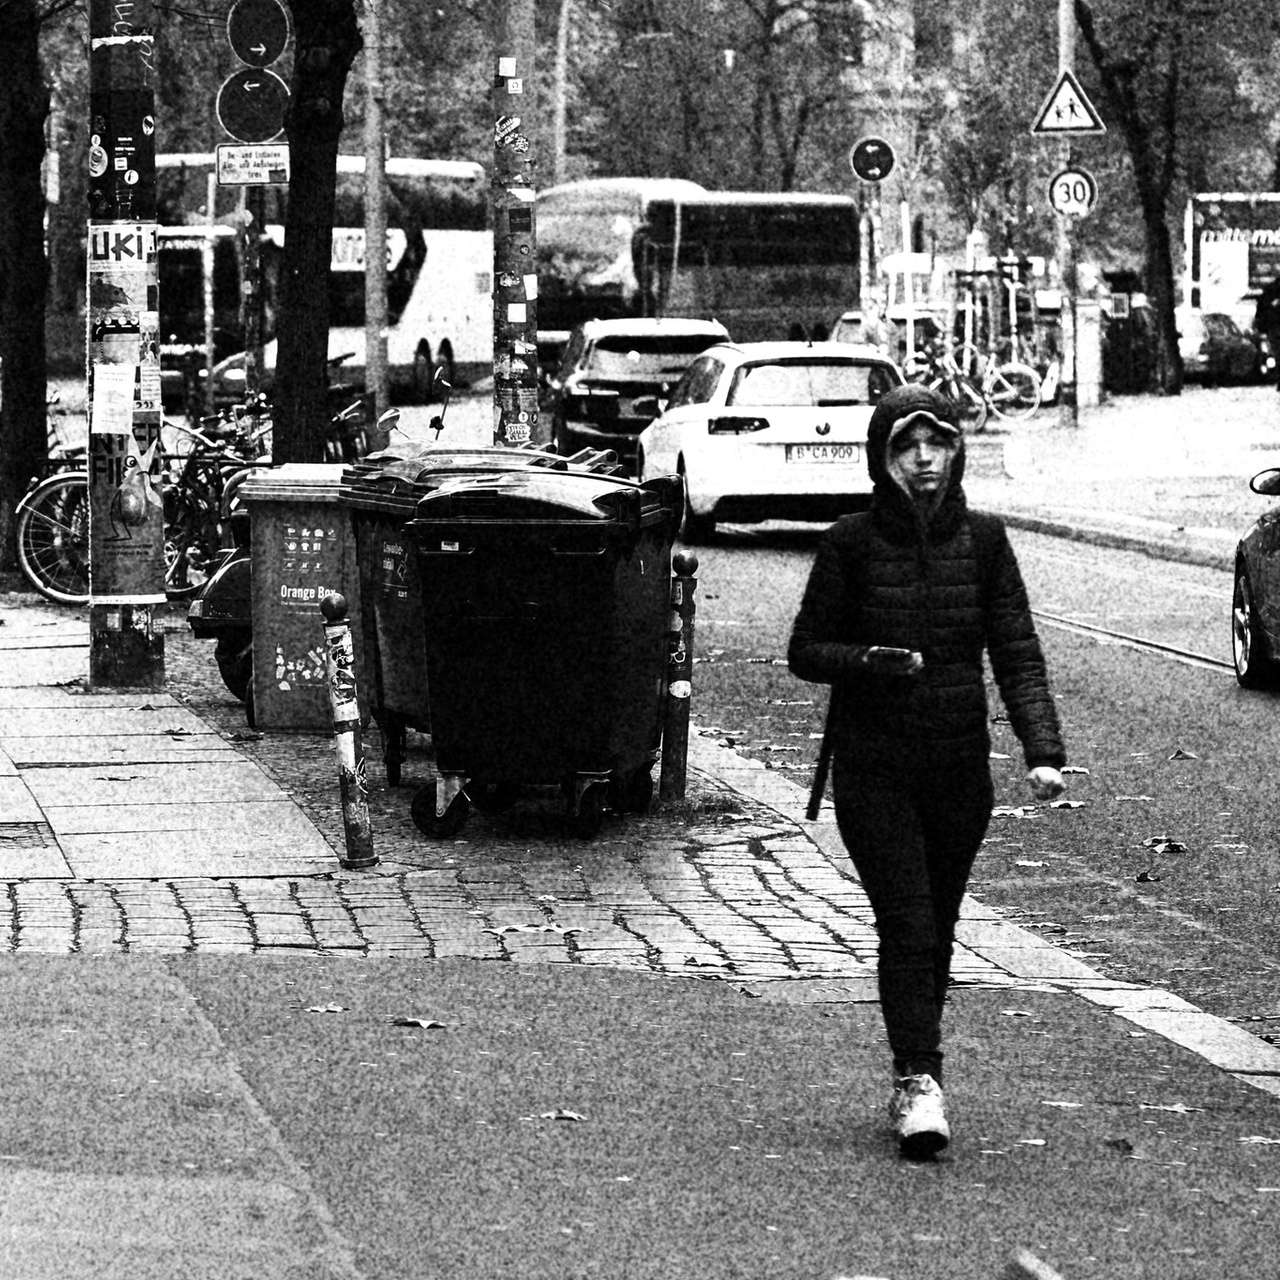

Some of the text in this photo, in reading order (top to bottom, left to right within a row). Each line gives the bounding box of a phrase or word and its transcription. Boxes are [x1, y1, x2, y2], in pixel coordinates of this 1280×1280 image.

[241, 150, 253, 159] und
[239, 160, 250, 169] und
[248, 171, 262, 179] frei
[1059, 181, 1086, 205] 30
[797, 447, 804, 459] B
[831, 446, 853, 459] 909
[280, 585, 316, 601] Orange
